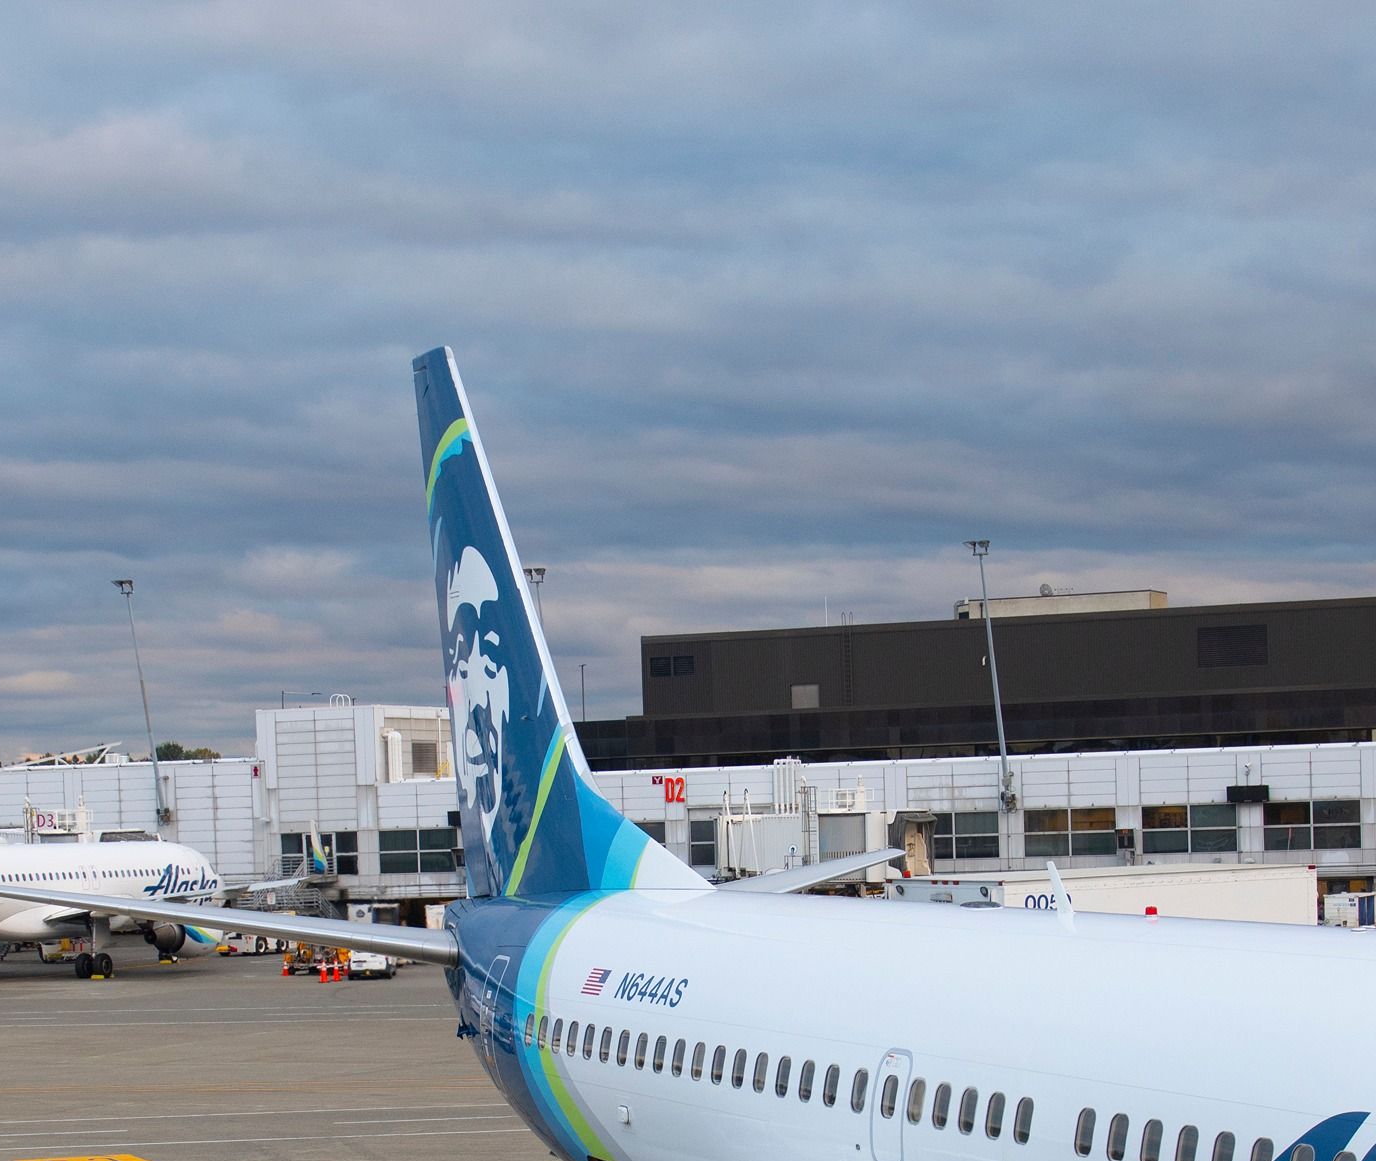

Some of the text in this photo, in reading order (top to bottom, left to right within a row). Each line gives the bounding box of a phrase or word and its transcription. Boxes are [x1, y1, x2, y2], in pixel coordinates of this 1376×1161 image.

[665, 777, 685, 803] D2
[37, 814, 54, 828] D3
[614, 972, 689, 1008] N644AS
